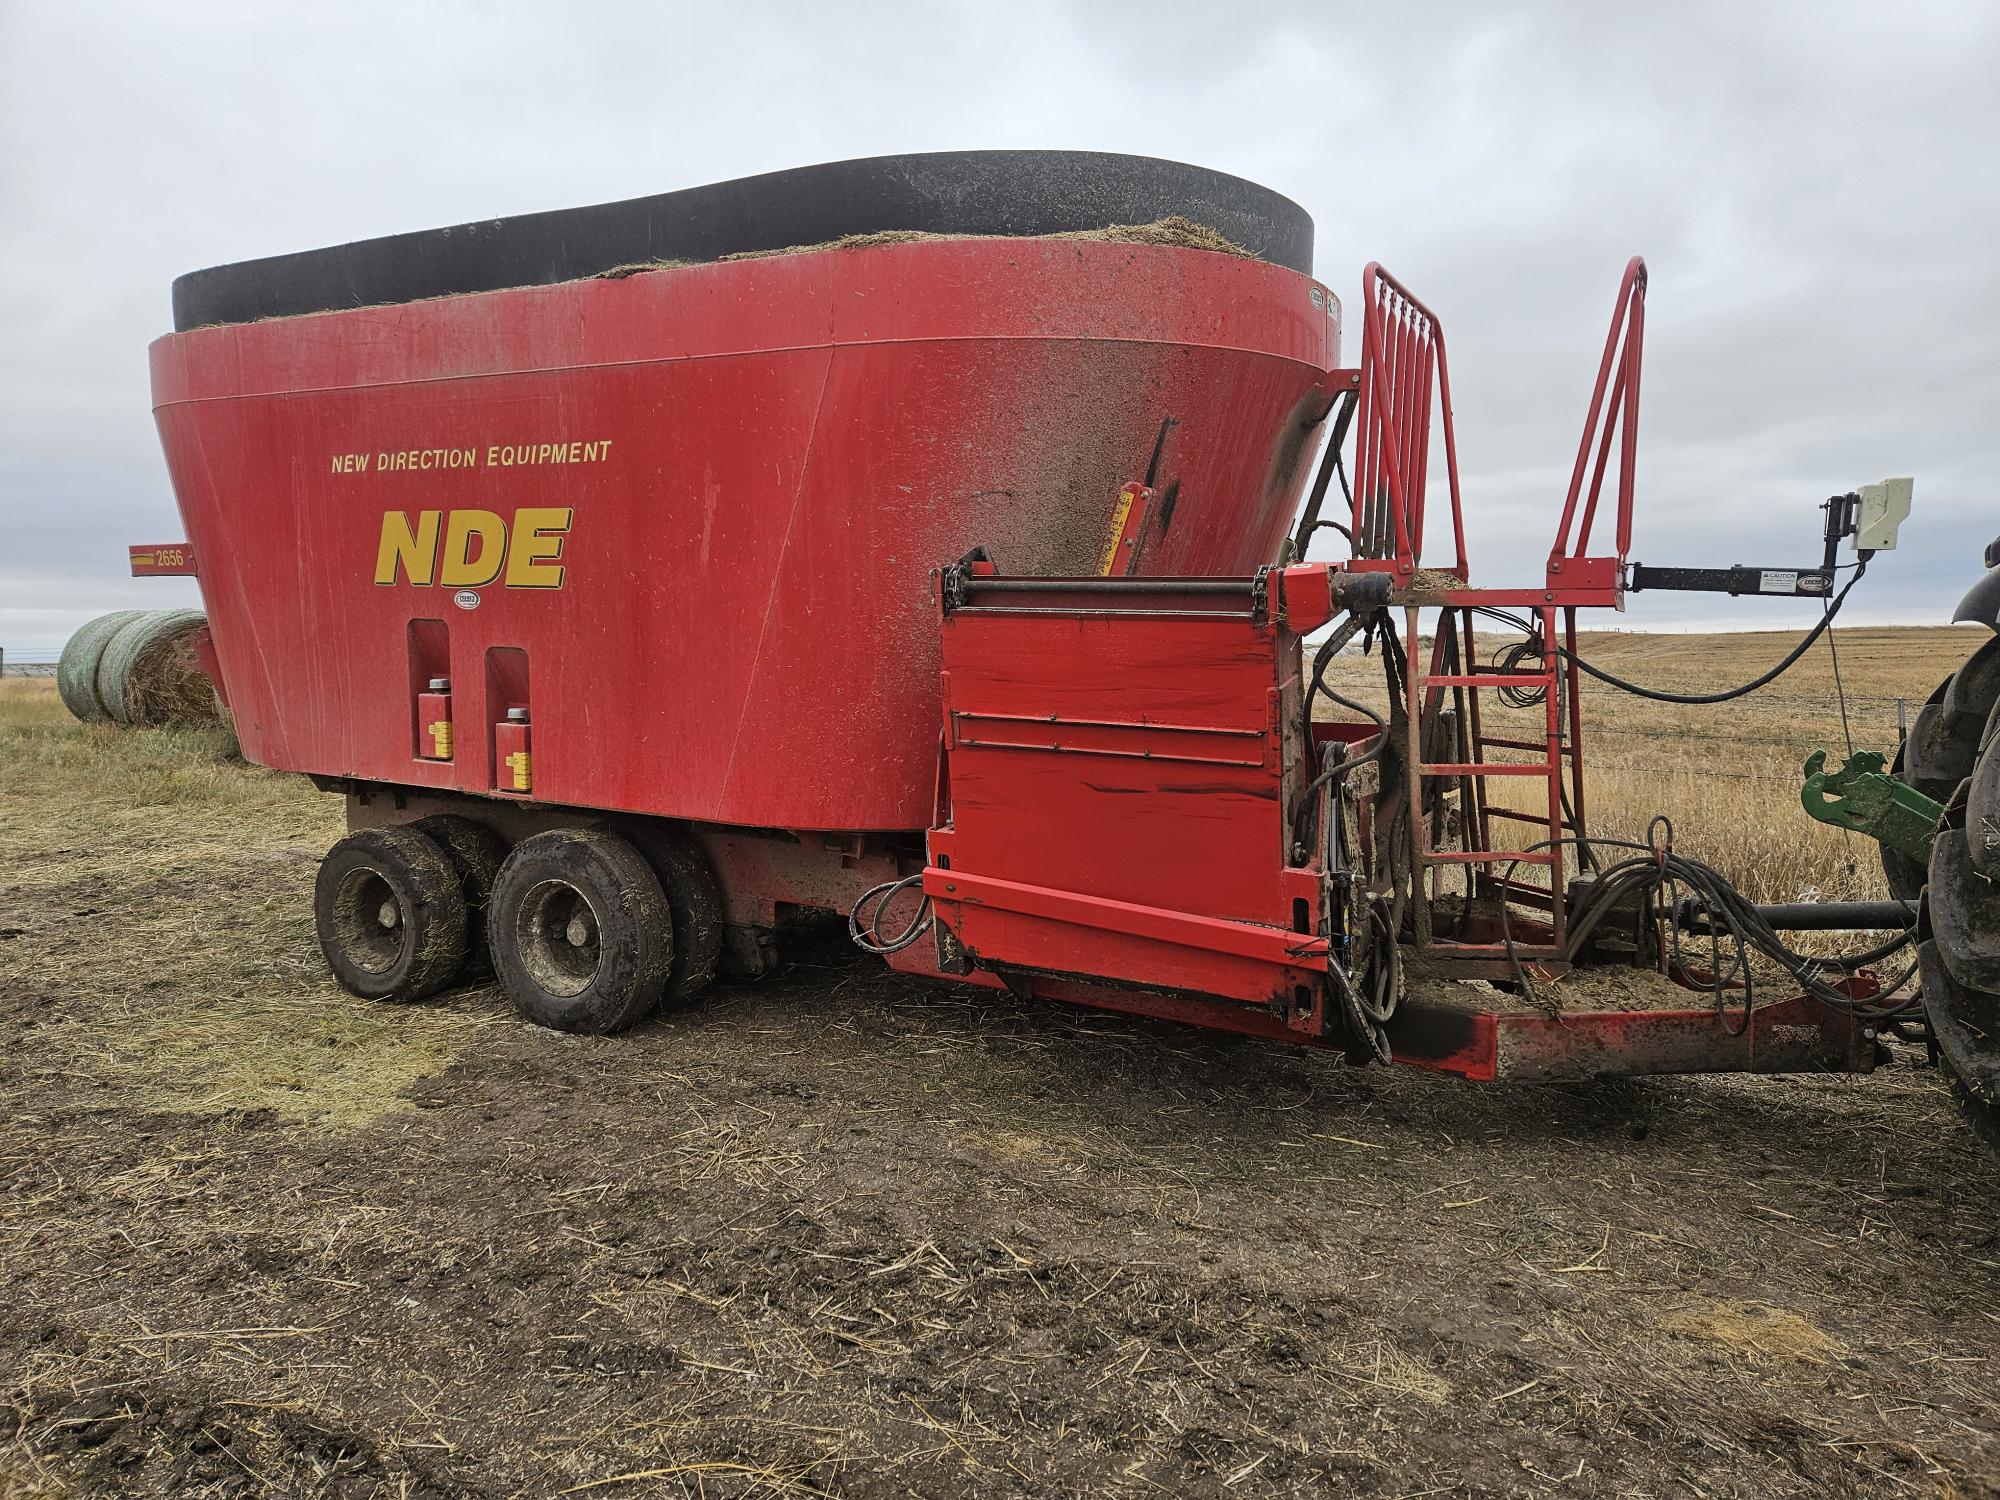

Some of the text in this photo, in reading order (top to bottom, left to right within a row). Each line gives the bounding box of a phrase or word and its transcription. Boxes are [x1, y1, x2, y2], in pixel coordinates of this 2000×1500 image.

[331, 440, 612, 473] NEW DIRECTION EQUIPMENT
[156, 549, 184, 567] 2656
[374, 507, 573, 589] NDE
